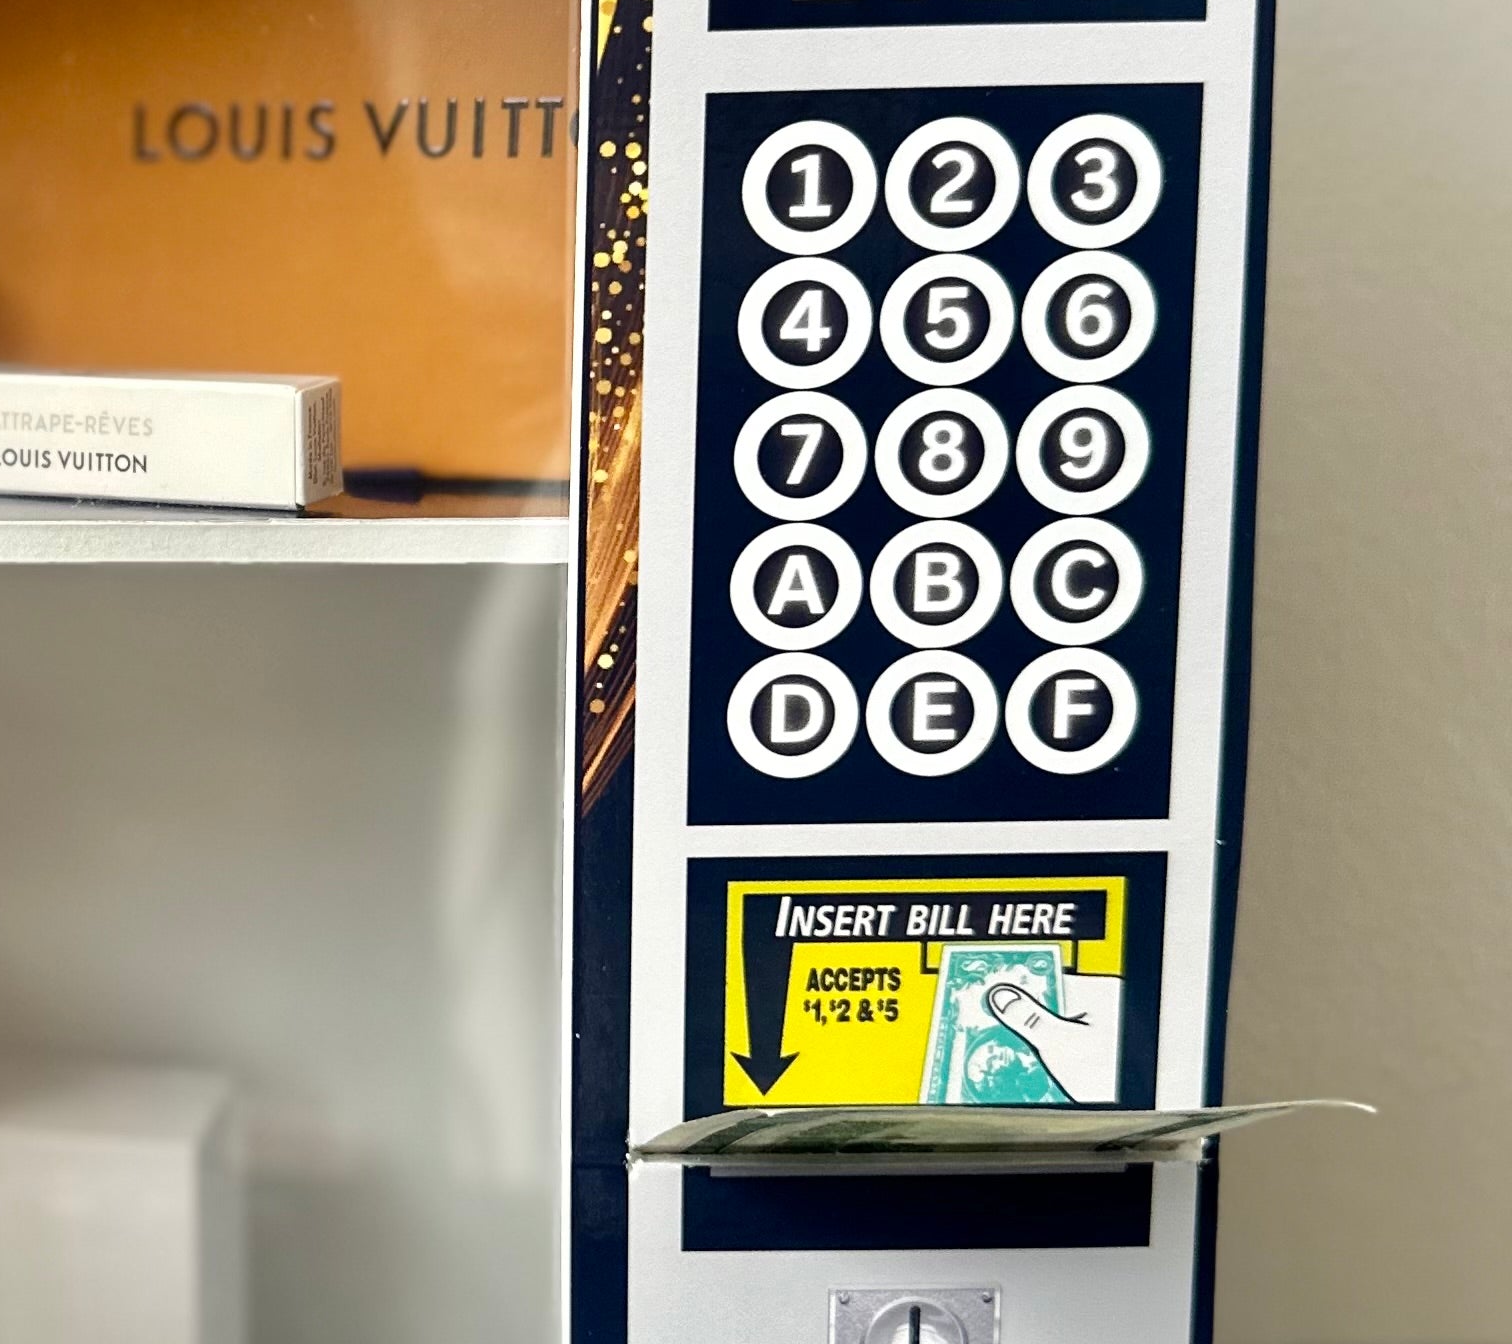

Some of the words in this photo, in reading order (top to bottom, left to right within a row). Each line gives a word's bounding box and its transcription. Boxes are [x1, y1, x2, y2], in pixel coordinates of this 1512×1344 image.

[133, 99, 337, 161] LOUIS
[788, 154, 833, 219] 1
[929, 148, 976, 214] 2
[1070, 146, 1118, 212] 3
[778, 289, 832, 353] 4
[923, 285, 972, 351] 5
[1065, 282, 1114, 348] 6
[57, 450, 148, 473] VUITTON
[780, 422, 824, 486] 7
[917, 419, 967, 484] 8
[1059, 416, 1107, 480] 9
[766, 554, 826, 616] A
[912, 551, 964, 613] B
[1050, 548, 1106, 611] C
[769, 683, 827, 744] D
[911, 680, 958, 742] E
[1052, 678, 1098, 739] F
[905, 903, 974, 937] BILL
[988, 902, 1076, 936] HERE
[805, 966, 901, 992] ACCEPTS
[829, 998, 851, 1022] $2
[856, 998, 875, 1023] &
[877, 997, 899, 1022] $5
